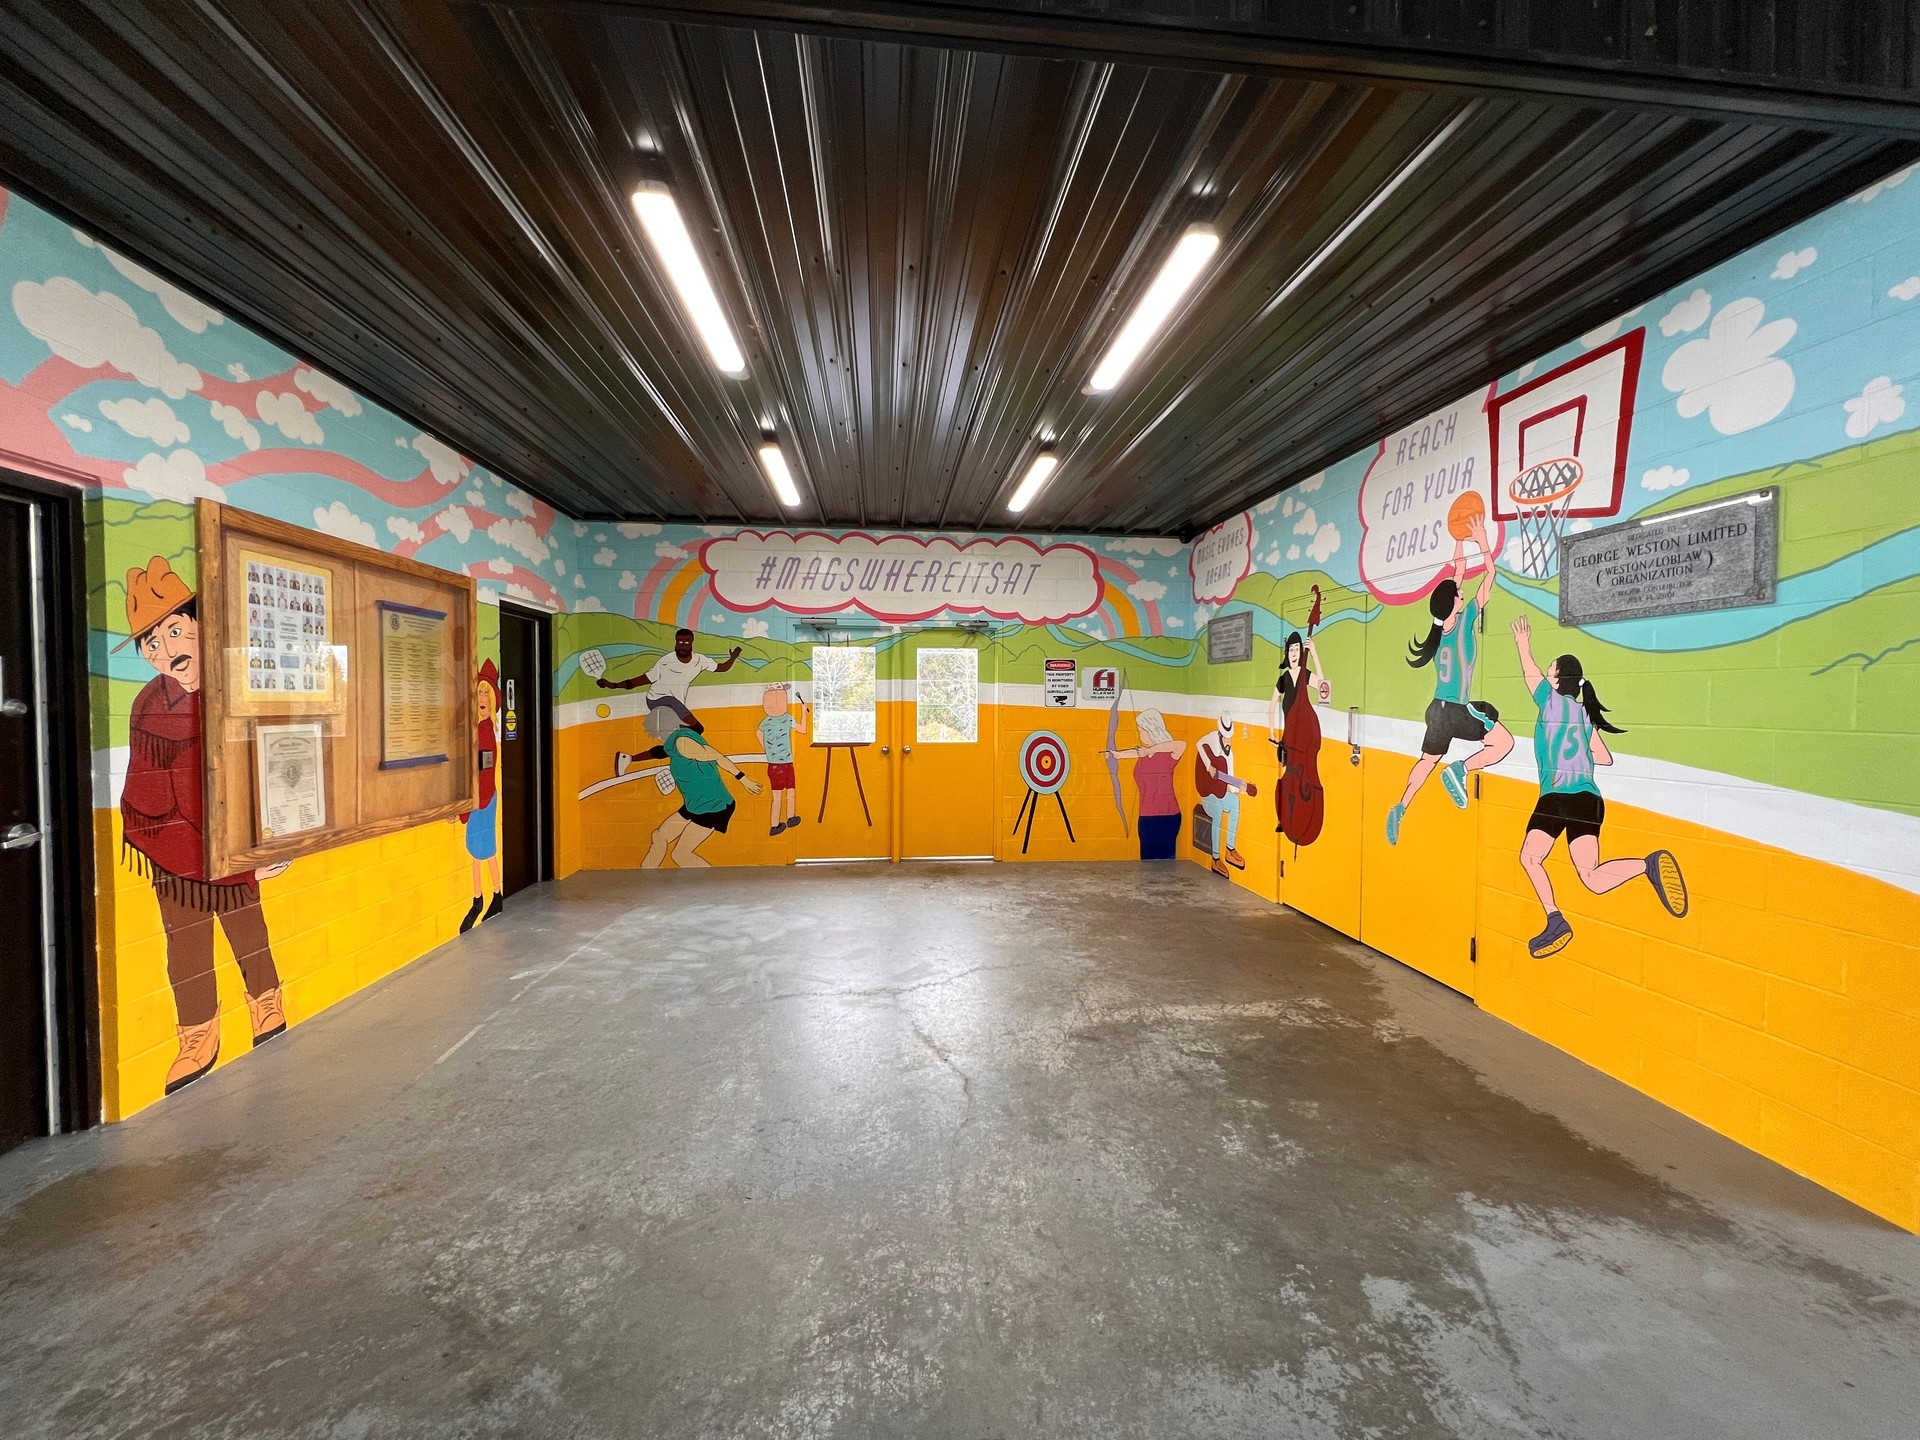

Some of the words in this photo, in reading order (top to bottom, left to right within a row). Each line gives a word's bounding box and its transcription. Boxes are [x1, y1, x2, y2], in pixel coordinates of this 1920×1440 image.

[1396, 411, 1458, 466] REACH
[1381, 481, 1414, 520] FOR
[1423, 456, 1475, 504] YOUR
[1217, 526, 1244, 555] EVOKES
[1385, 519, 1442, 563] GOALS
[1573, 548, 1620, 568] GEORGE
[1626, 536, 1681, 557] WESTON
[1687, 522, 1748, 546] LIMITED
[756, 555, 1042, 596] #MAGSWHEREITSAT
[1611, 563, 1693, 586] ORGANIZATION
[1437, 646, 1453, 684] 9
